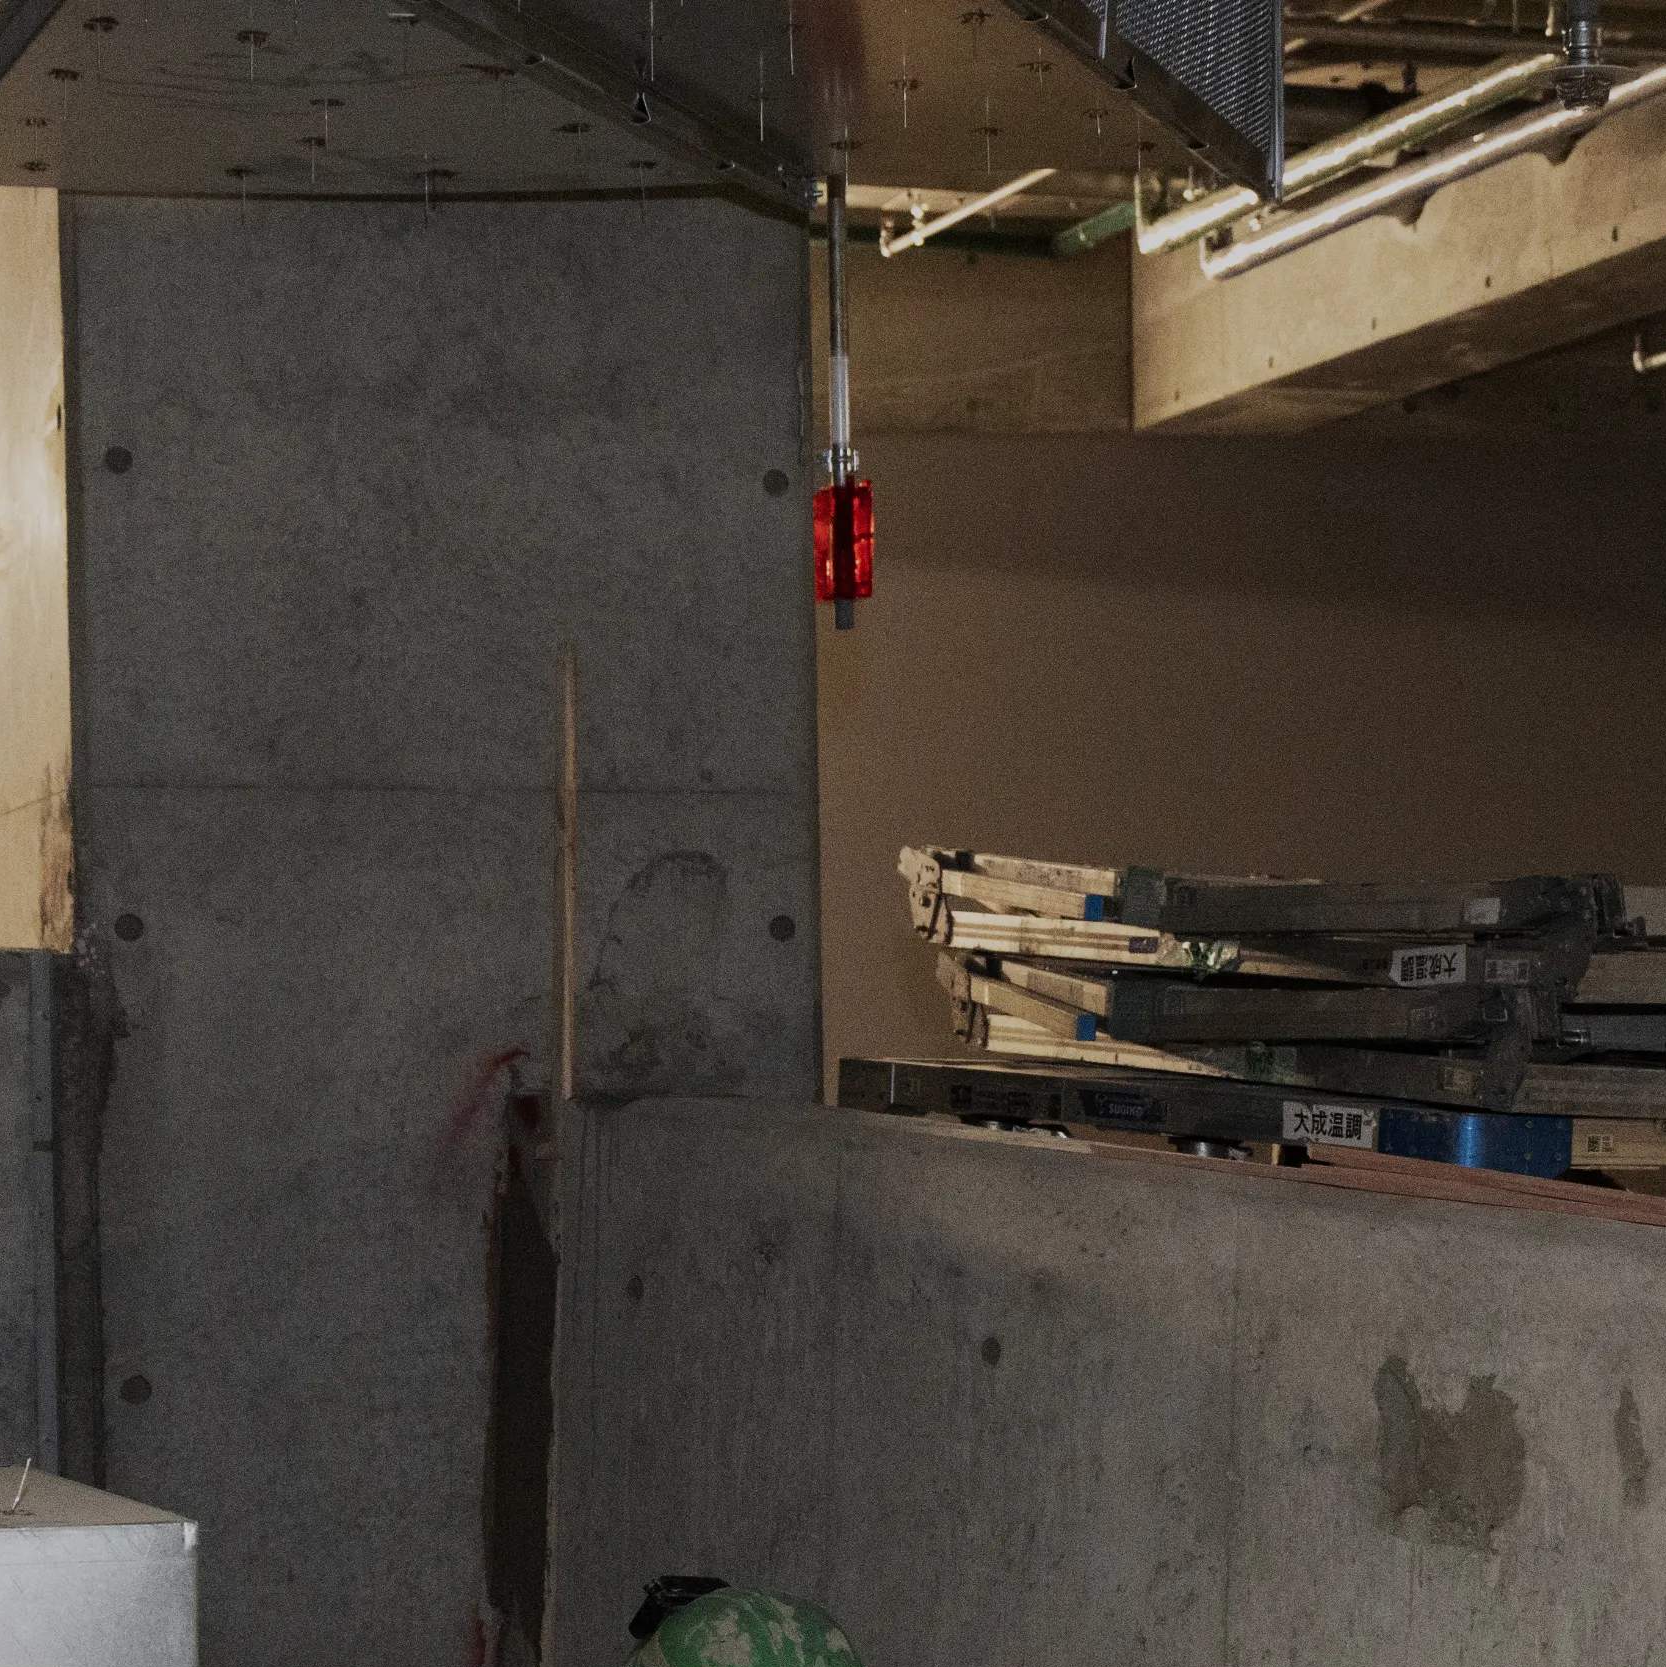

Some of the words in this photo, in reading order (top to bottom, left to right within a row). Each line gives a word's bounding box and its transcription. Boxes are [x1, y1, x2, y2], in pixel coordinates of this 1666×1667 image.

[1401, 952, 1457, 982] 大成温調
[1294, 1111, 1362, 1140] 大成温調
